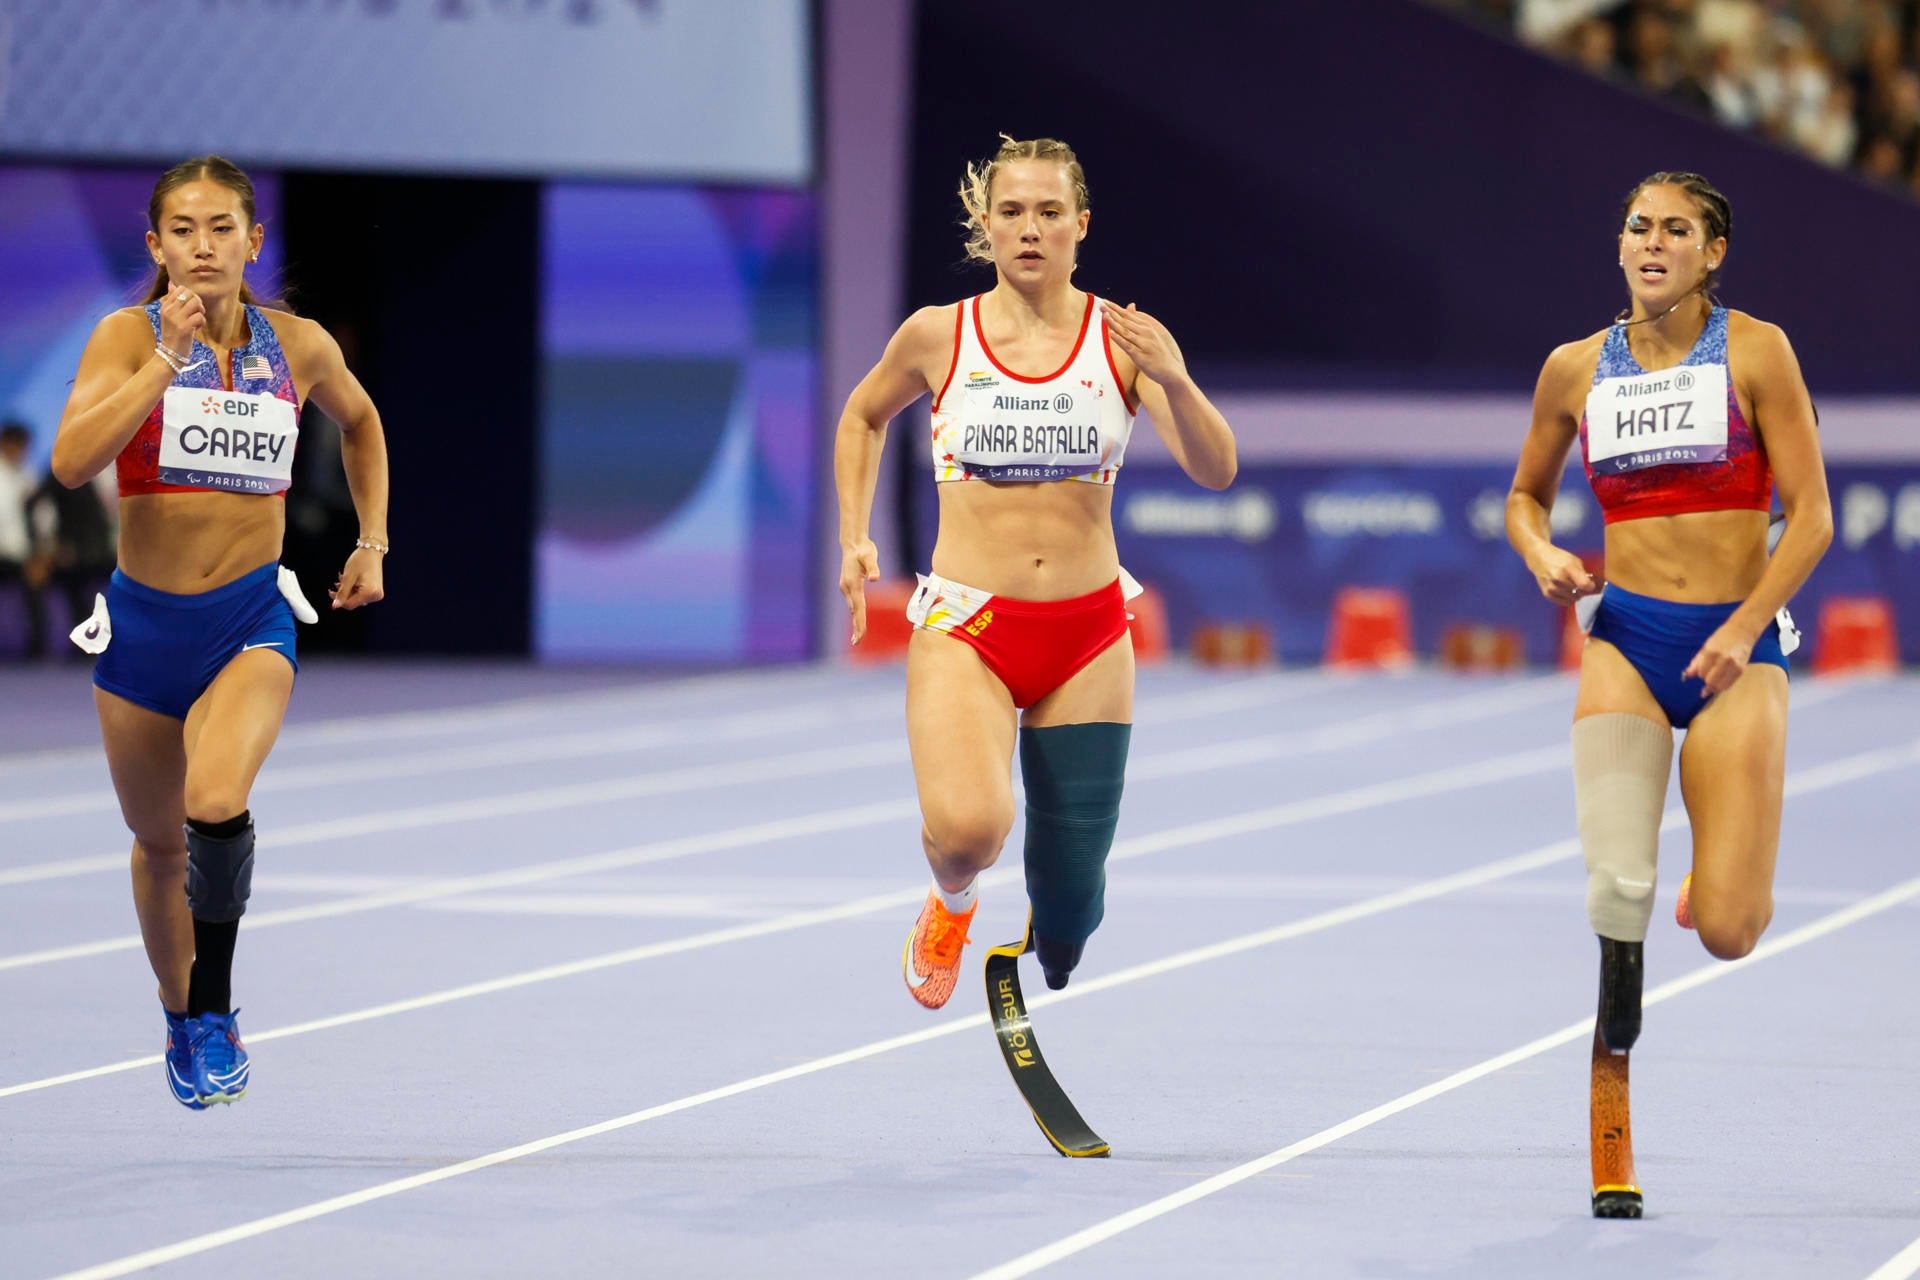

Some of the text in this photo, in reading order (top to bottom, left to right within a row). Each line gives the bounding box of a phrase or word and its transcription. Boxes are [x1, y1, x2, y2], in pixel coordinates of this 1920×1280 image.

[1615, 379, 1671, 398] Allianz
[993, 395, 1049, 411] Allianz
[1616, 401, 1694, 439] HATZ
[179, 425, 286, 463] CAREY
[964, 424, 1098, 454] PINAR BATALLA
[1631, 449, 1697, 466] PARIS 2024
[207, 476, 270, 490] PARIS 2024
[1007, 468, 1040, 477] PARIS
[965, 610, 994, 637] ESP
[998, 979, 1027, 1048] ÖSSUR
